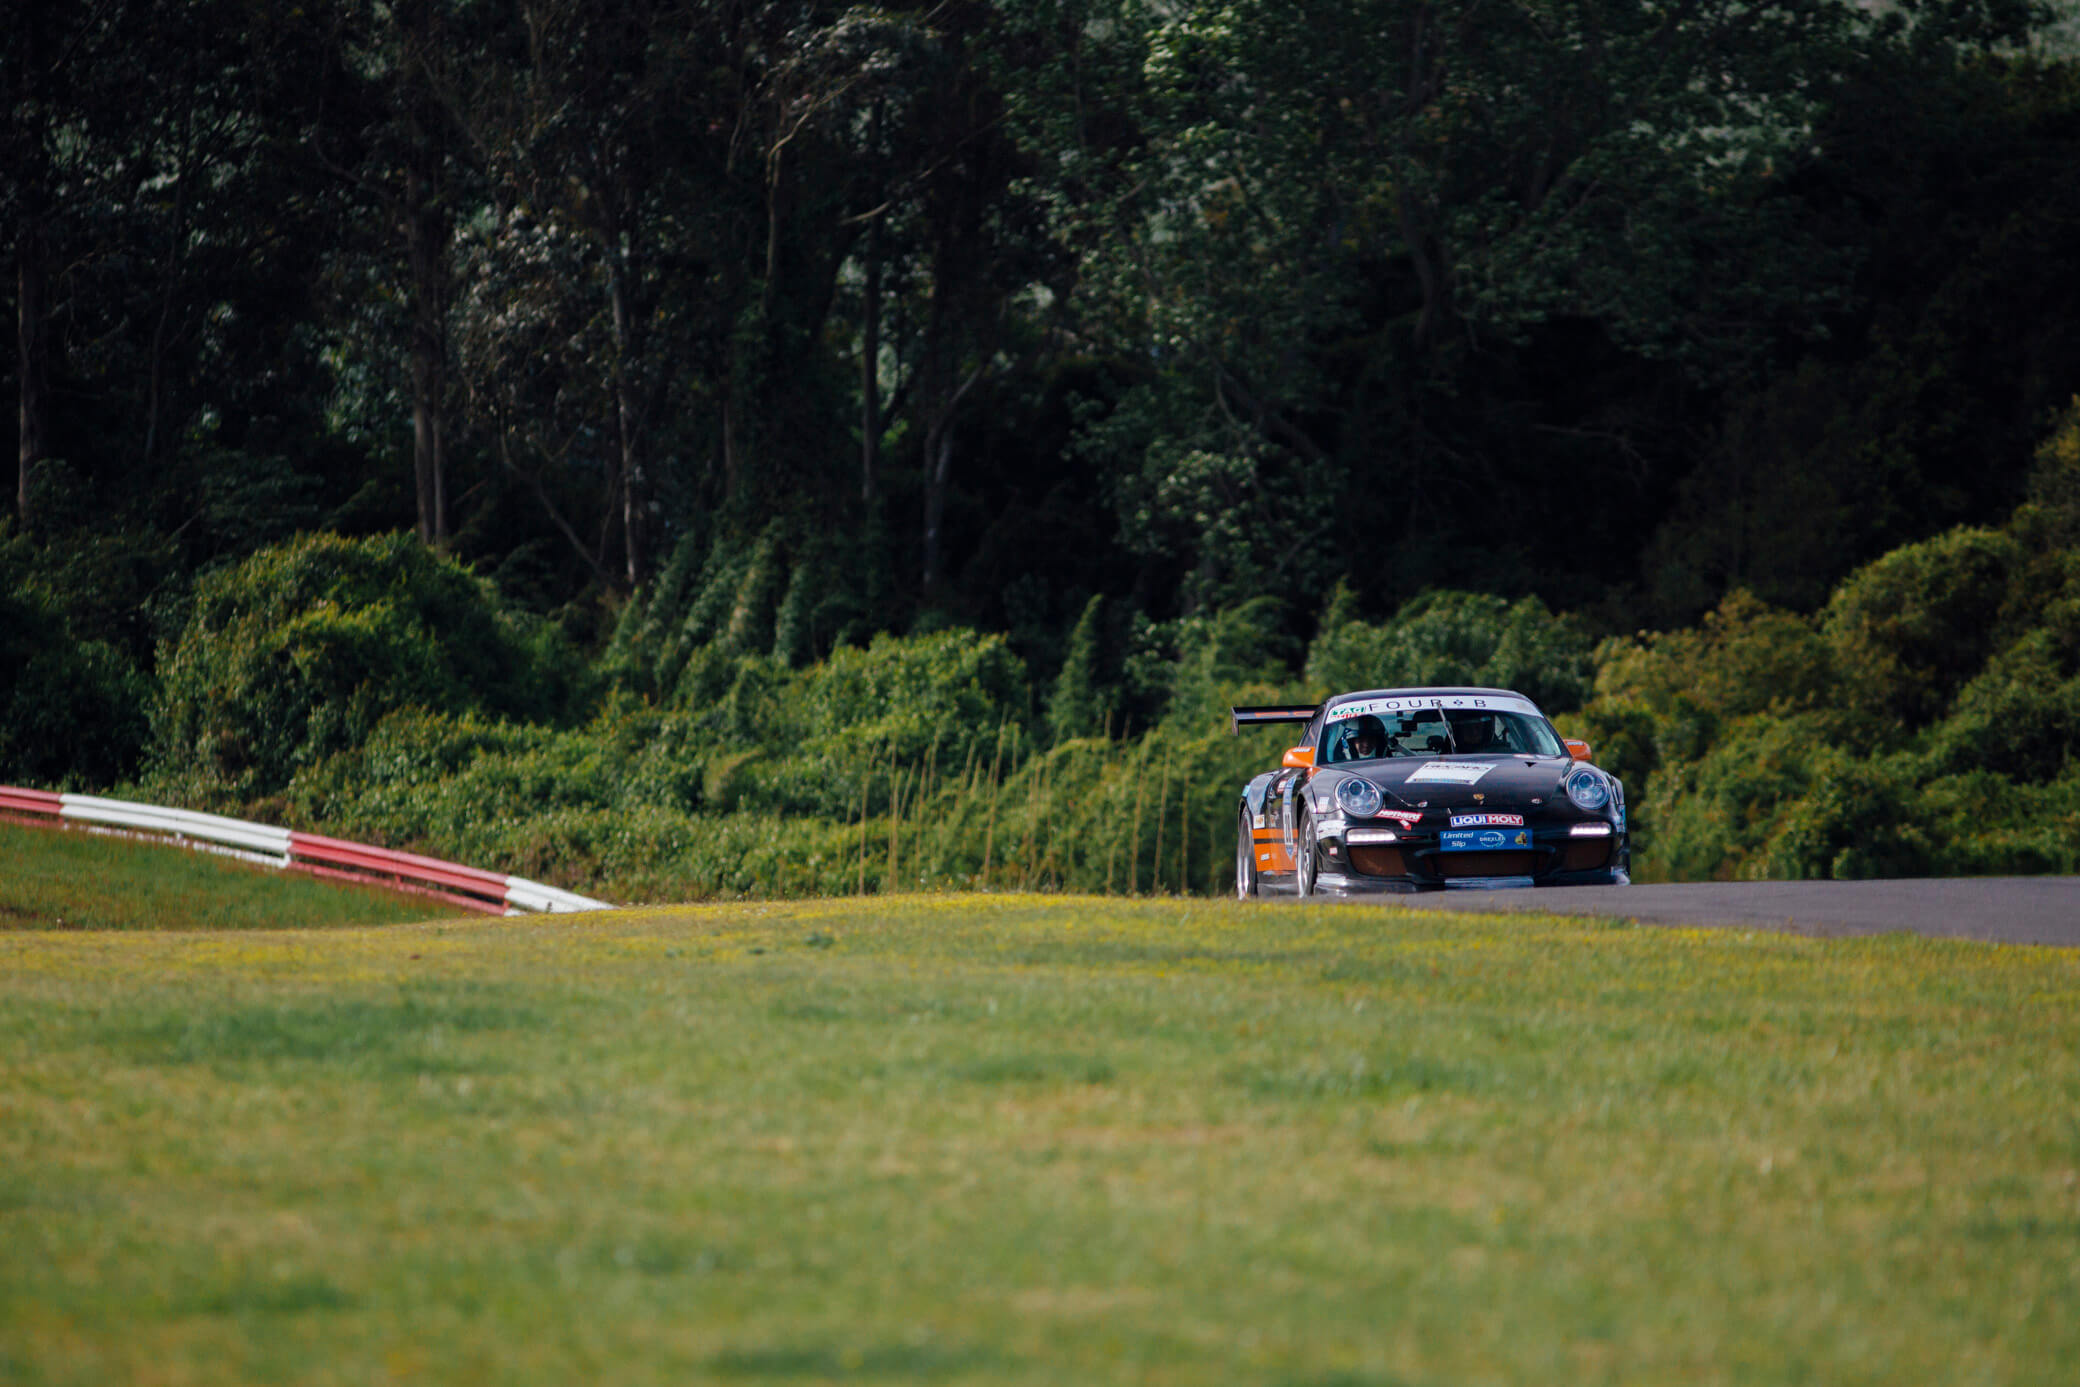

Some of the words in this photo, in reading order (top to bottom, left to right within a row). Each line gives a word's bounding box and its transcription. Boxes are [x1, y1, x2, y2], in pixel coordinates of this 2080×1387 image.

[1368, 699, 1443, 712] FOUR
[1474, 699, 1487, 708] B
[1453, 815, 1487, 825] LIQUI
[1488, 815, 1522, 824] MOLY
[1442, 831, 1474, 839] Limited
[1451, 840, 1467, 848] Slip
